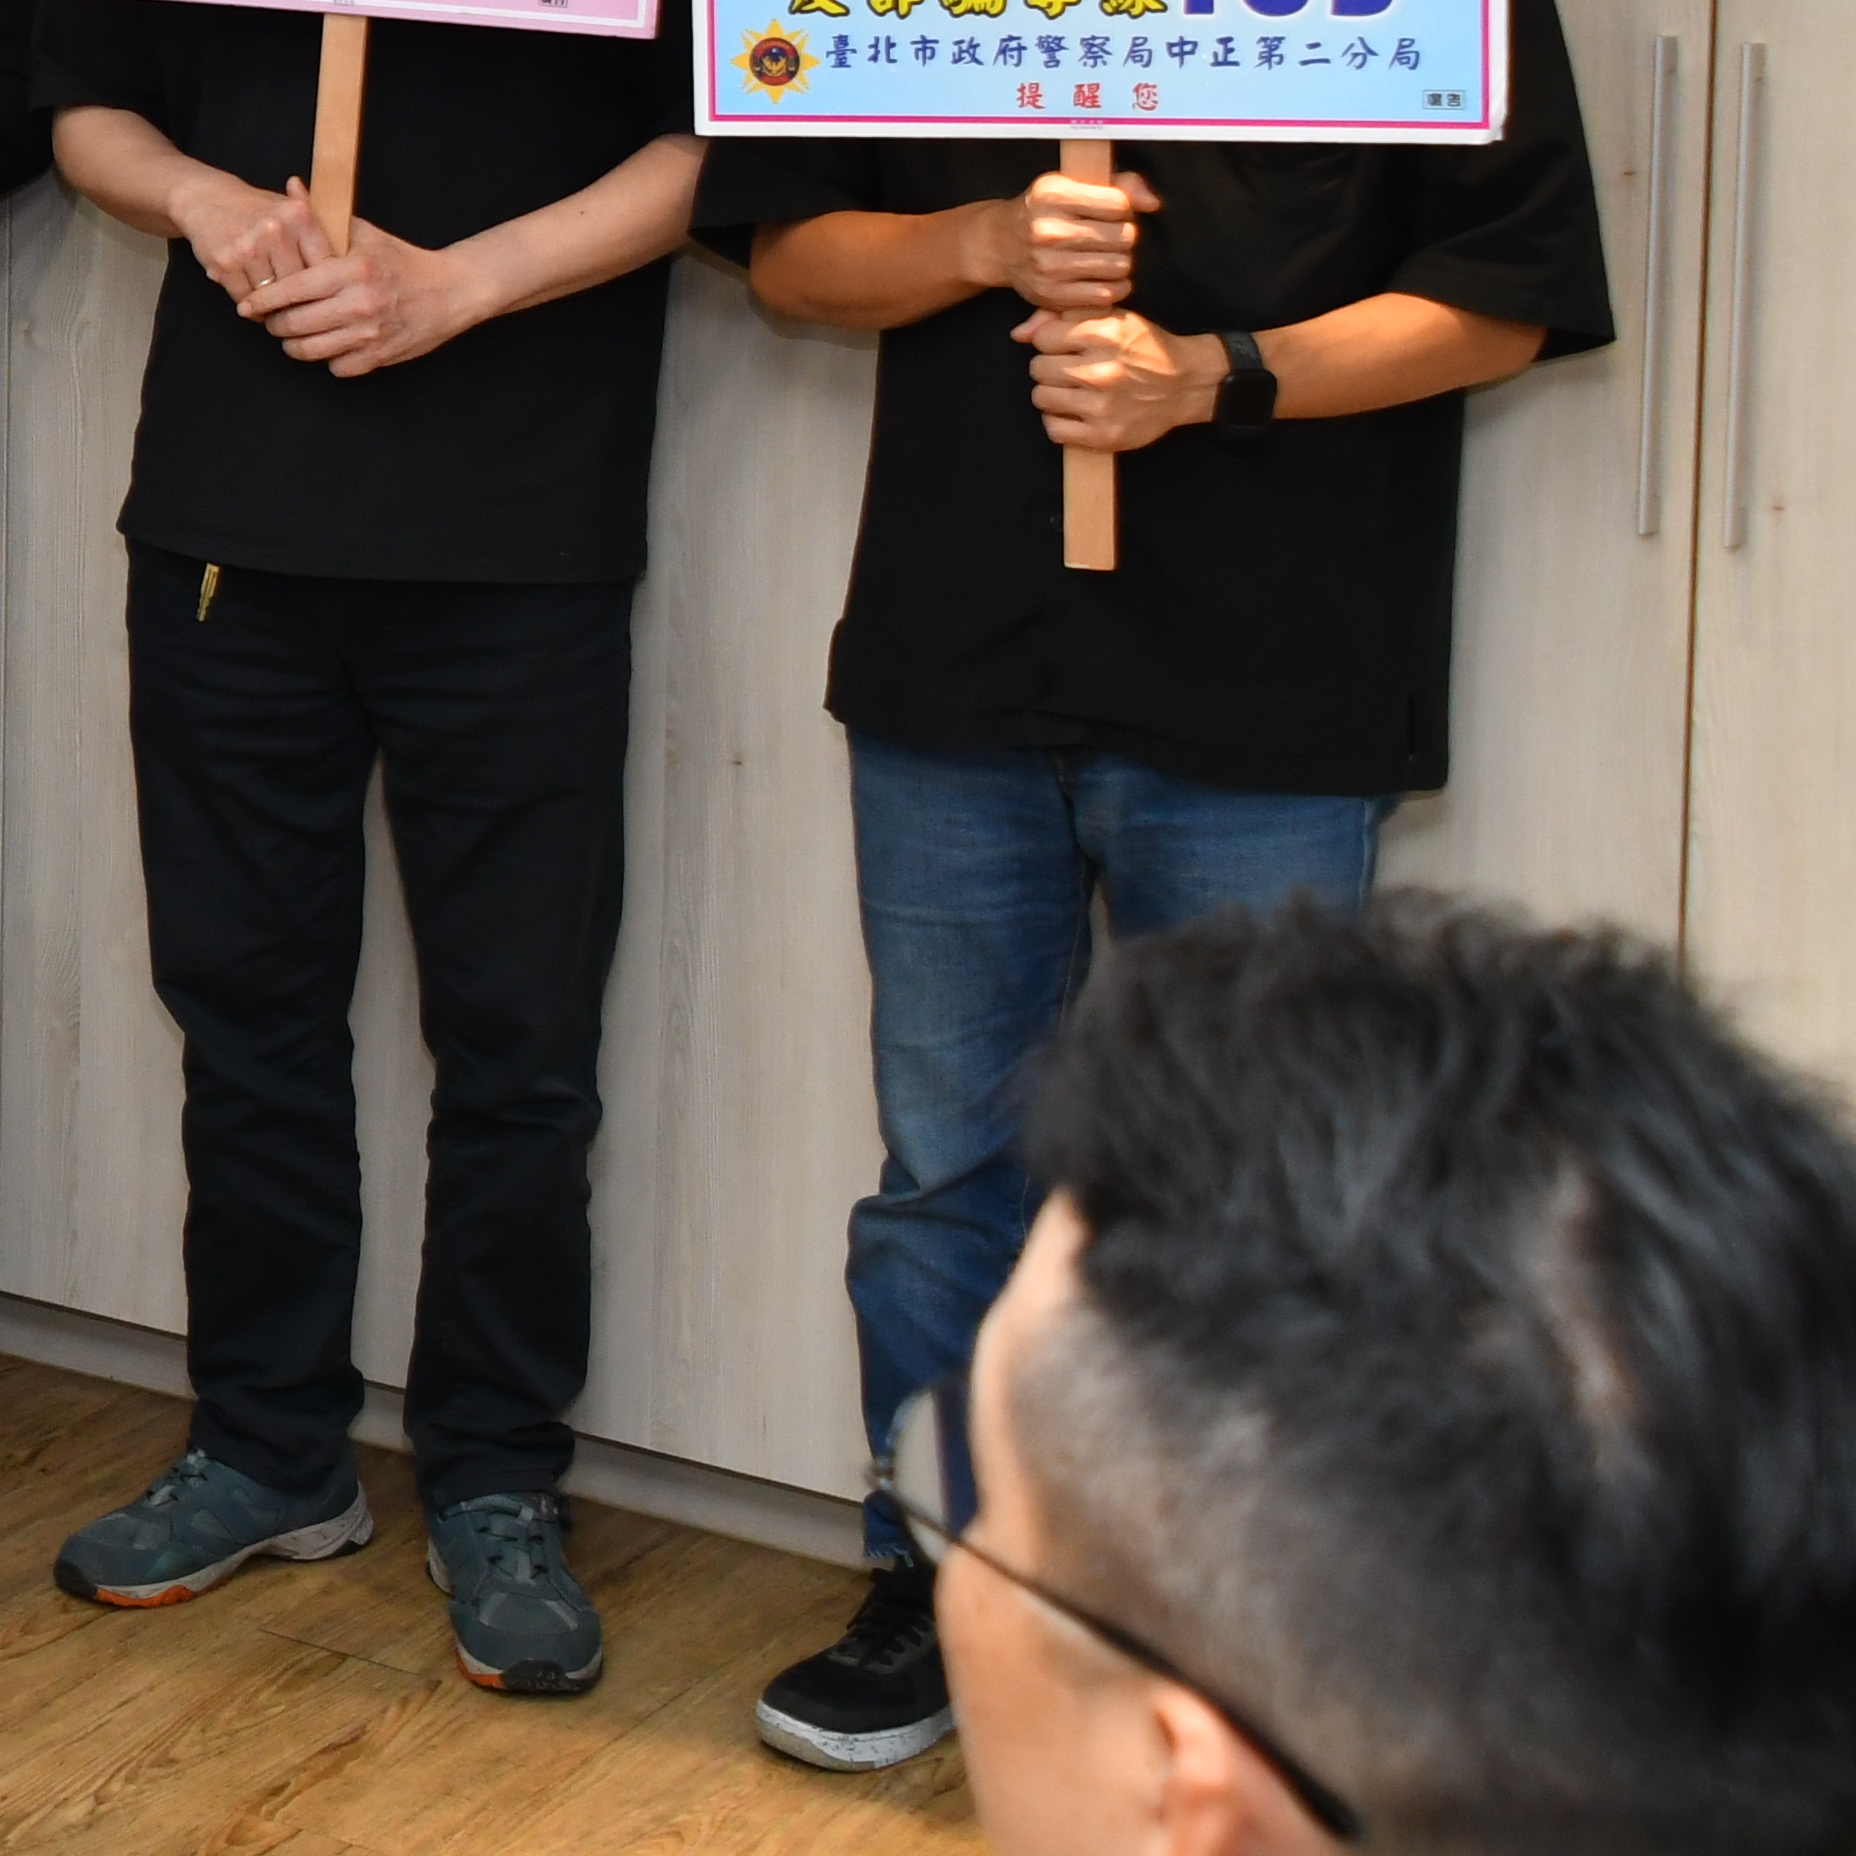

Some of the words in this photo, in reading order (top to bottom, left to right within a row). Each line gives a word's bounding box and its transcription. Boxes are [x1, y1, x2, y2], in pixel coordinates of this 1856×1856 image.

[825, 35, 1422, 71] 臺北市政府警察局中正第二分局
[1017, 81, 1160, 111] 提醒您
